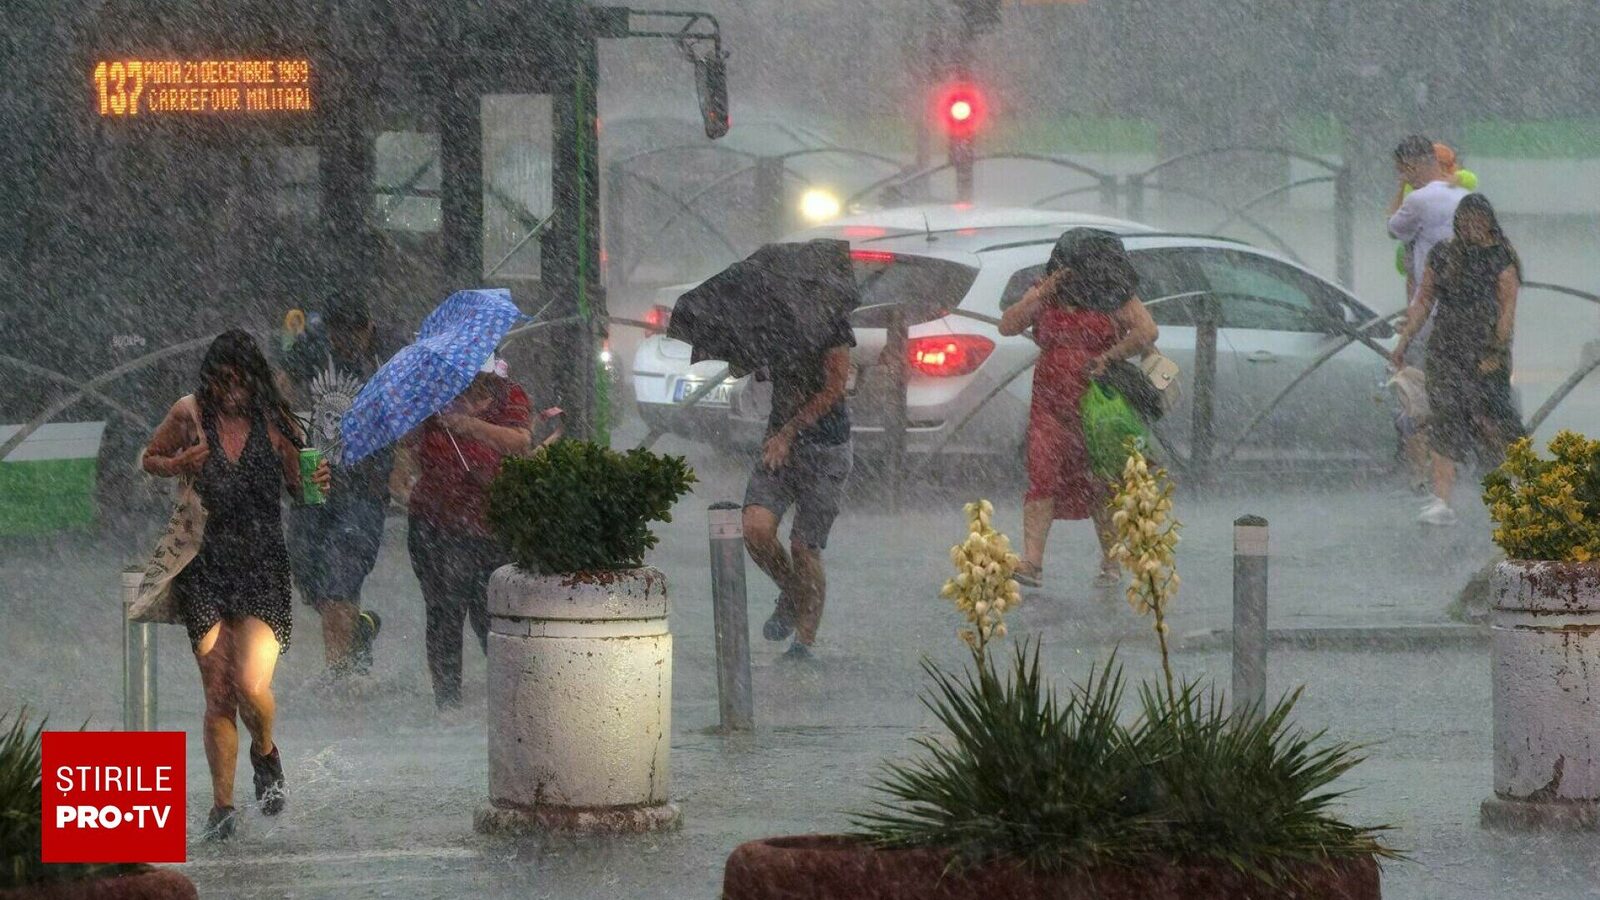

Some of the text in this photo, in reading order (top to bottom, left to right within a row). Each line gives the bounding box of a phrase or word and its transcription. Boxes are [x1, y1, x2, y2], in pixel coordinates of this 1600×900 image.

[144, 61, 181, 83] PIATA
[184, 61, 198, 83] 21
[201, 61, 274, 83] DECEMBRIE
[94, 61, 144, 115] 137
[148, 88, 310, 111] CARREFOUR MILITARI
